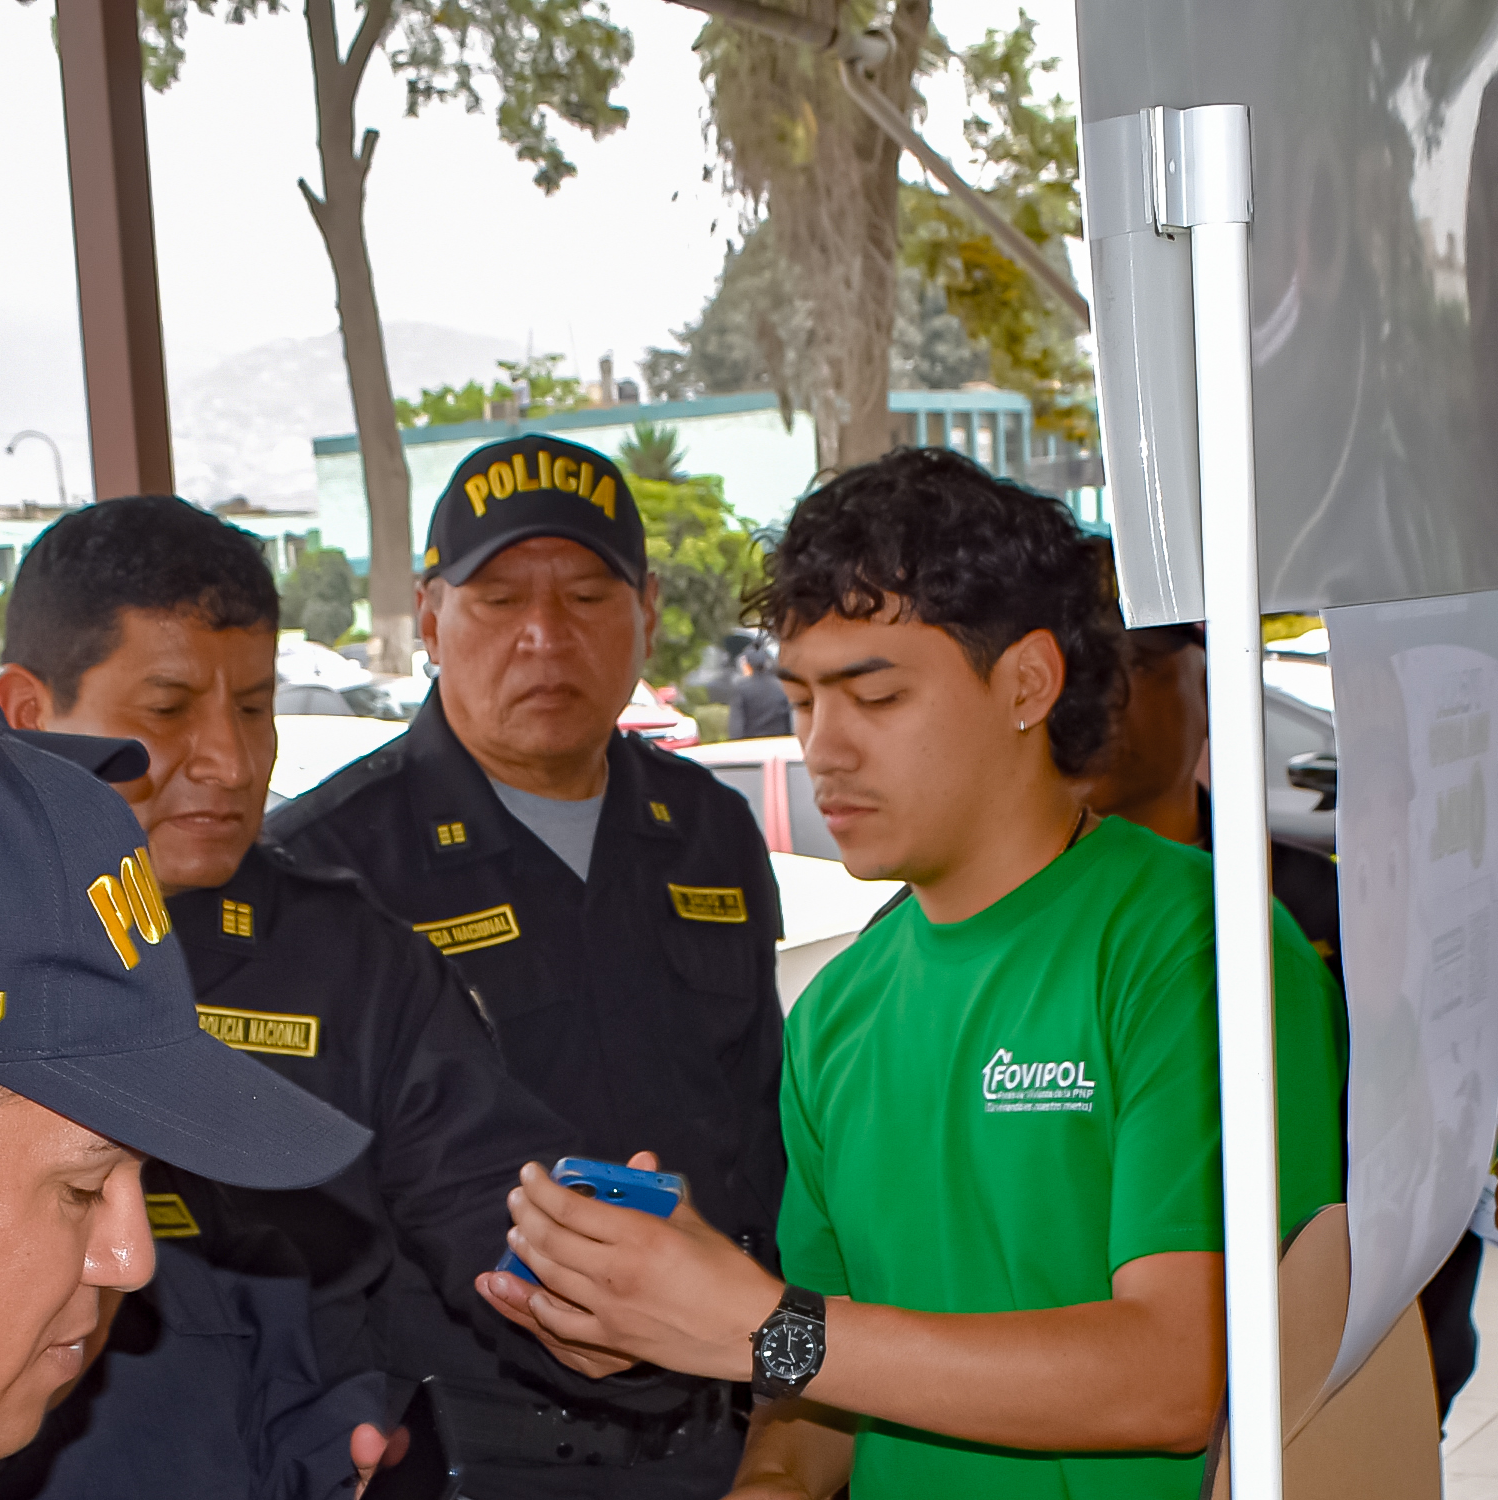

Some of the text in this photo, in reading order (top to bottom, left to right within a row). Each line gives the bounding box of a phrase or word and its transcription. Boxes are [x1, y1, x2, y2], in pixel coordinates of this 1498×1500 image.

[464, 450, 616, 520] POLICIA
[248, 1019, 307, 1048] NACIONAL
[991, 1061, 1096, 1091] FOVIPOL
